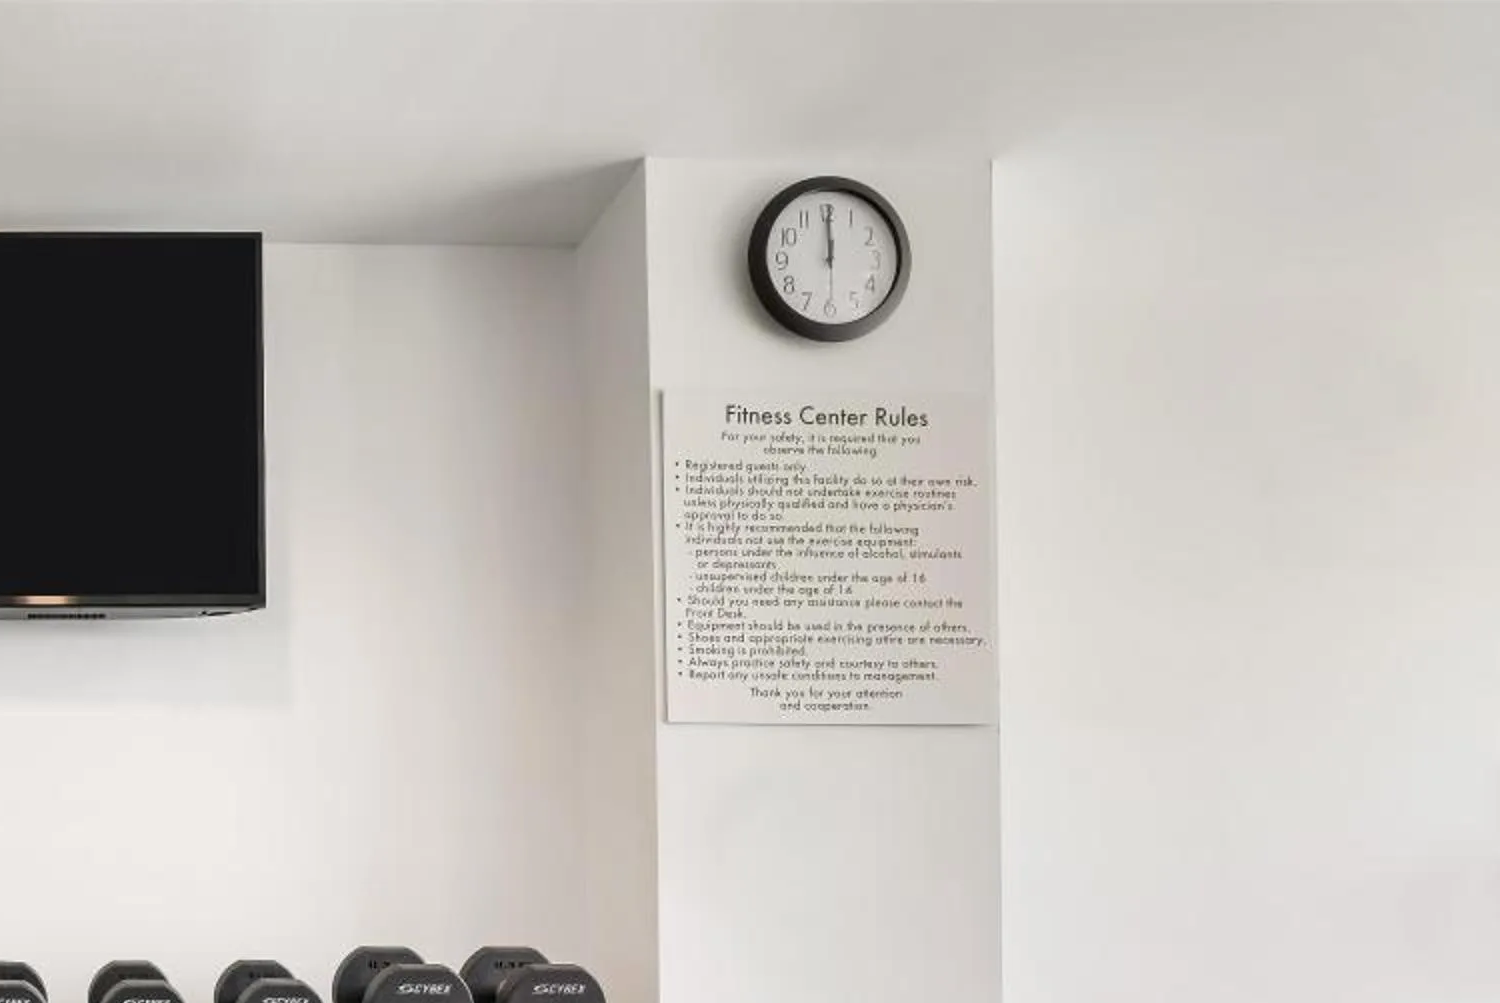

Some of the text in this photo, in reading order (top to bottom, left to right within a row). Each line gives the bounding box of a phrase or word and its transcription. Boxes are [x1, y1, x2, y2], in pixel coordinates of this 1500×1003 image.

[799, 210, 810, 229] 11
[779, 227, 797, 247] 10
[863, 226, 875, 246] 2
[774, 251, 789, 271] 9
[869, 250, 881, 271] 3
[782, 275, 795, 295] 8
[864, 273, 875, 294] 4
[801, 291, 813, 311] 7
[823, 298, 837, 317] 6
[725, 406, 929, 427] Fitness Center Rules
[685, 473, 744, 484] Individuals
[685, 484, 745, 496] Individuals
[827, 499, 849, 509] and
[743, 523, 823, 534] recommended
[869, 524, 919, 536] following
[871, 575, 894, 585] age
[797, 586, 820, 596] age
[728, 599, 749, 609] you
[751, 596, 780, 607] need
[782, 599, 804, 609] any
[723, 632, 745, 643] and
